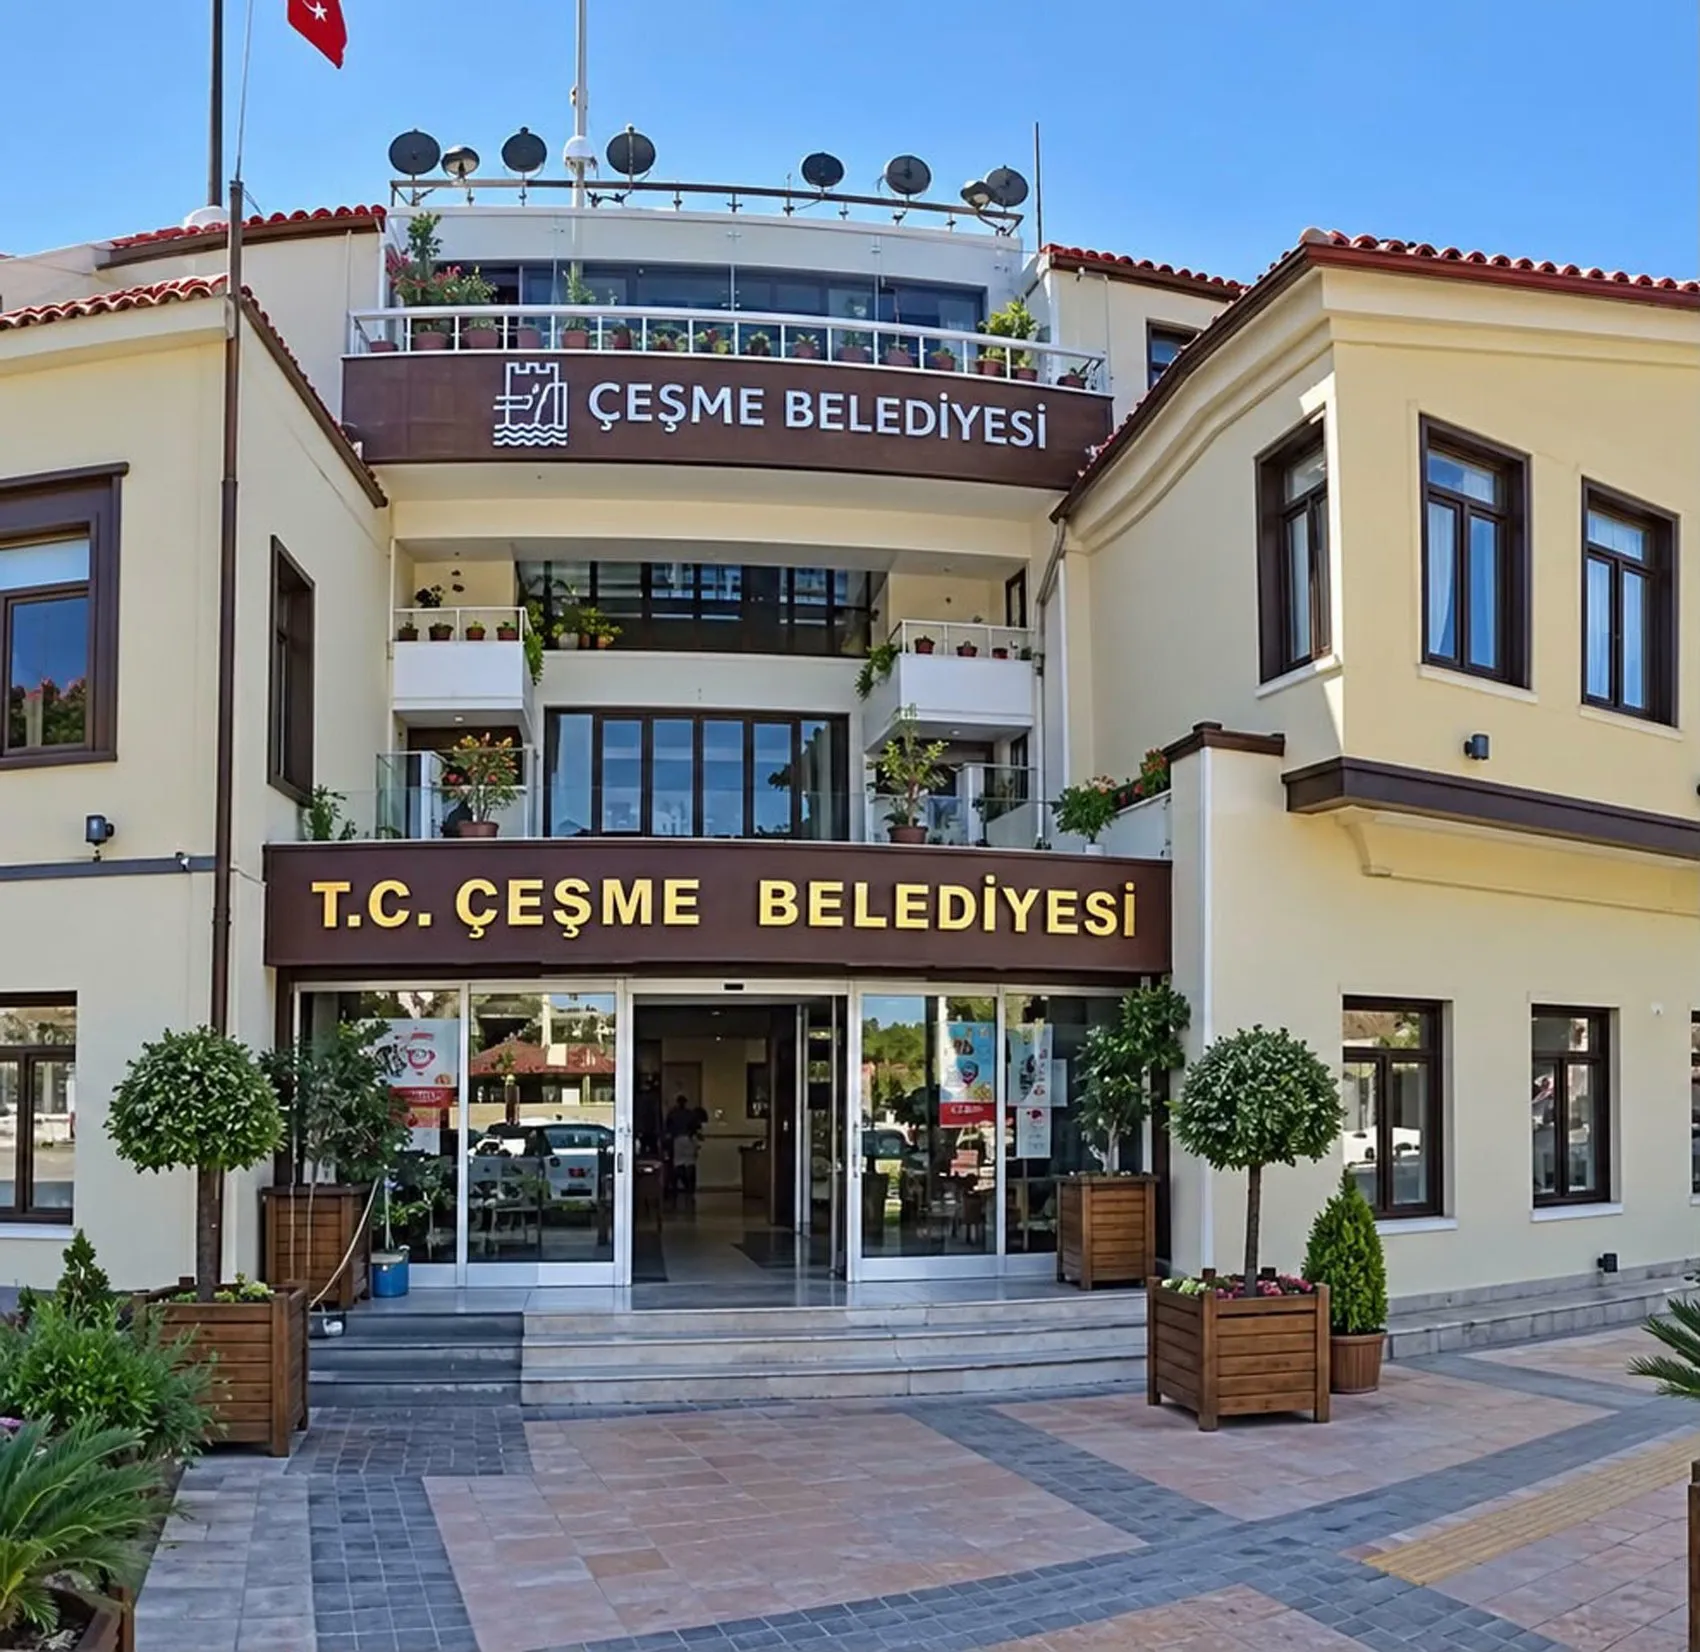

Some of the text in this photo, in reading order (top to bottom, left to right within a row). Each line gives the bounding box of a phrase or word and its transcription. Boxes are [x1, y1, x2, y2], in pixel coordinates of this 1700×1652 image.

[587, 381, 1047, 450] ÇEŞME BELEDİYESİ
[309, 873, 1136, 940] T.C. ÇEŞME BELEDİYESİ
